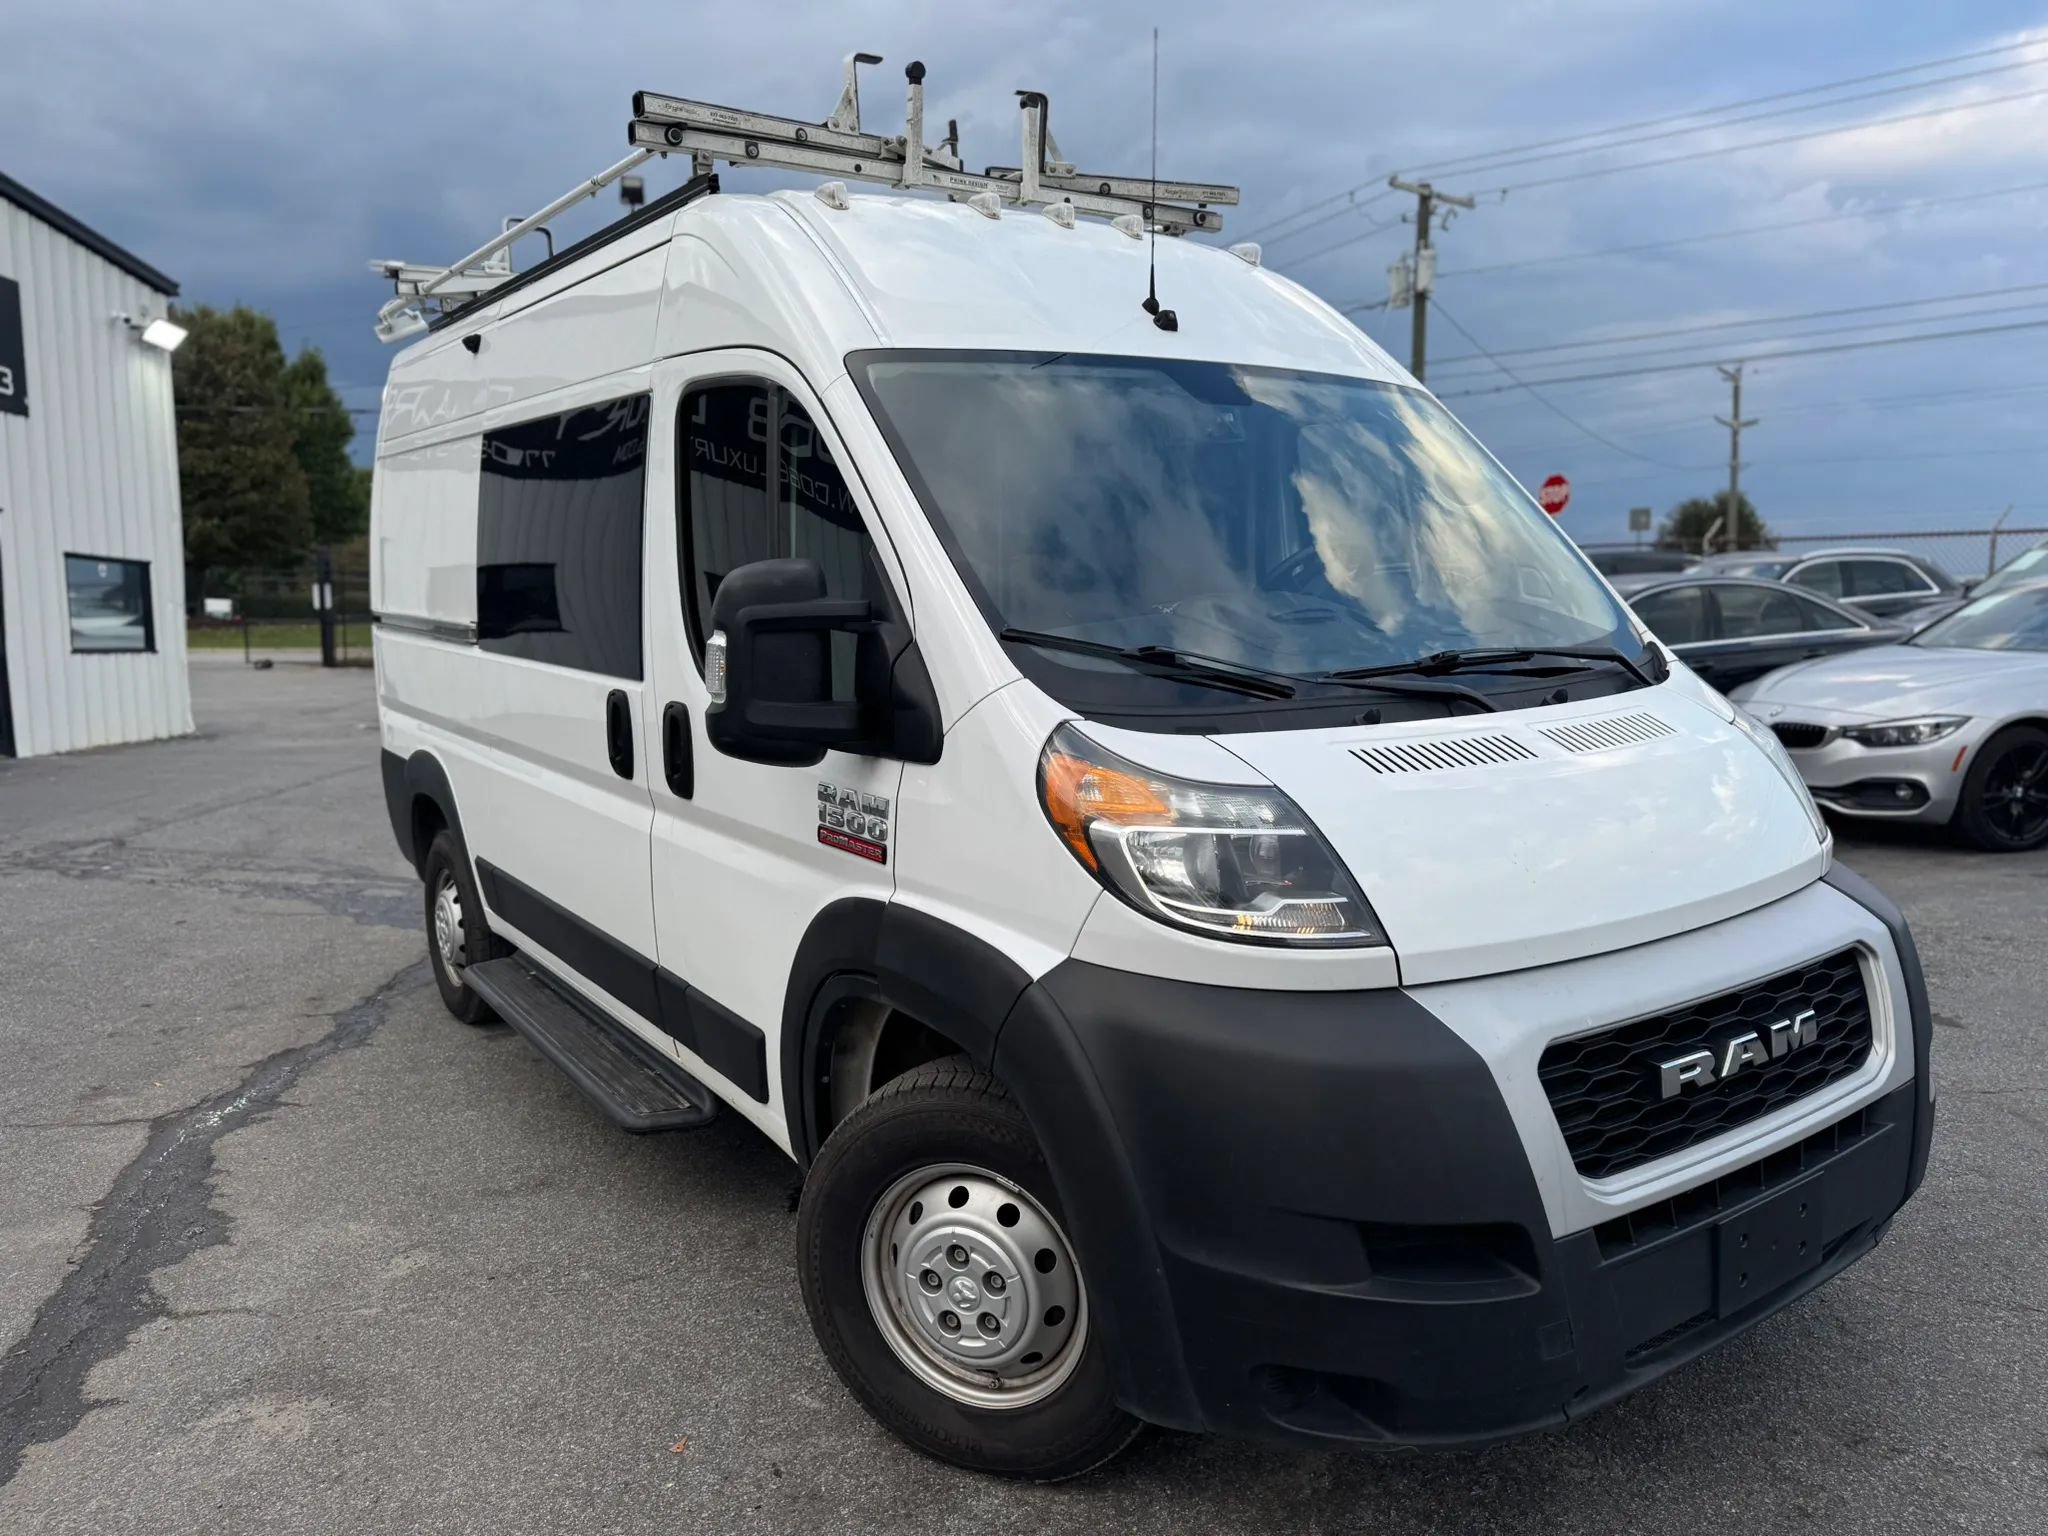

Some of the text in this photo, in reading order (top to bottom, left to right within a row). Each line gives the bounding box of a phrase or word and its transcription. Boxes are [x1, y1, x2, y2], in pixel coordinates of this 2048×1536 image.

[1540, 483, 1569, 504] STOP
[817, 780, 890, 820] RAM
[817, 801, 889, 842] 1500
[1660, 1008, 1818, 1100] RAM
